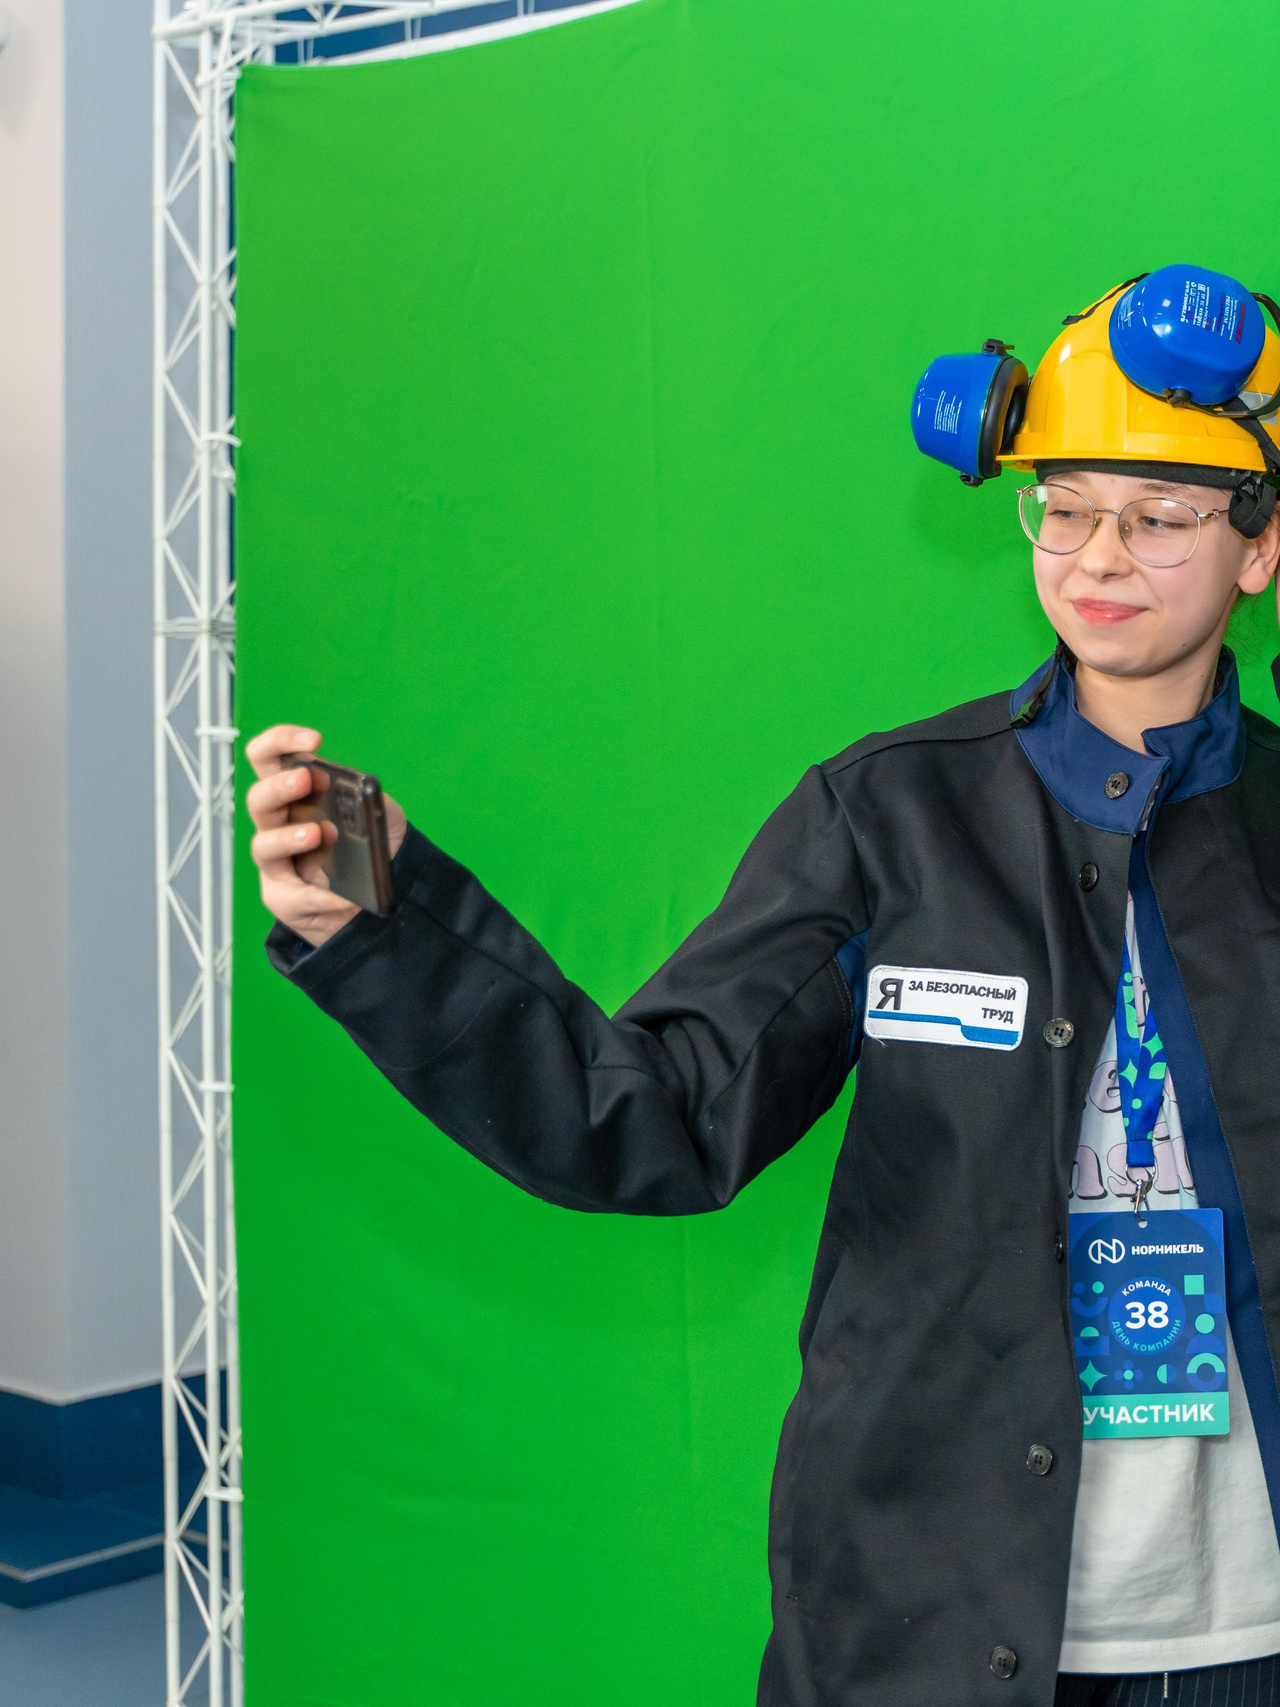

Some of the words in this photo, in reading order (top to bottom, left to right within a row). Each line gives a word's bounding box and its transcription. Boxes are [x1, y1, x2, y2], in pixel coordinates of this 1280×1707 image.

[875, 977, 904, 1011] Я
[908, 980, 924, 992] ЗА
[926, 981, 1018, 1001] БЕЗОПАСНЫЙ
[981, 1007, 1014, 1025] ТРУД
[1131, 1244, 1205, 1256] НОРНИКЕЛЬ
[1121, 1280, 1172, 1297] КОМАНДА
[1125, 1301, 1170, 1330] 38
[1112, 1321, 1130, 1345] ДЕНЬ
[1133, 1319, 1182, 1352] КОМПАНИИ
[1083, 1403, 1215, 1425] УЧАСТНИК
